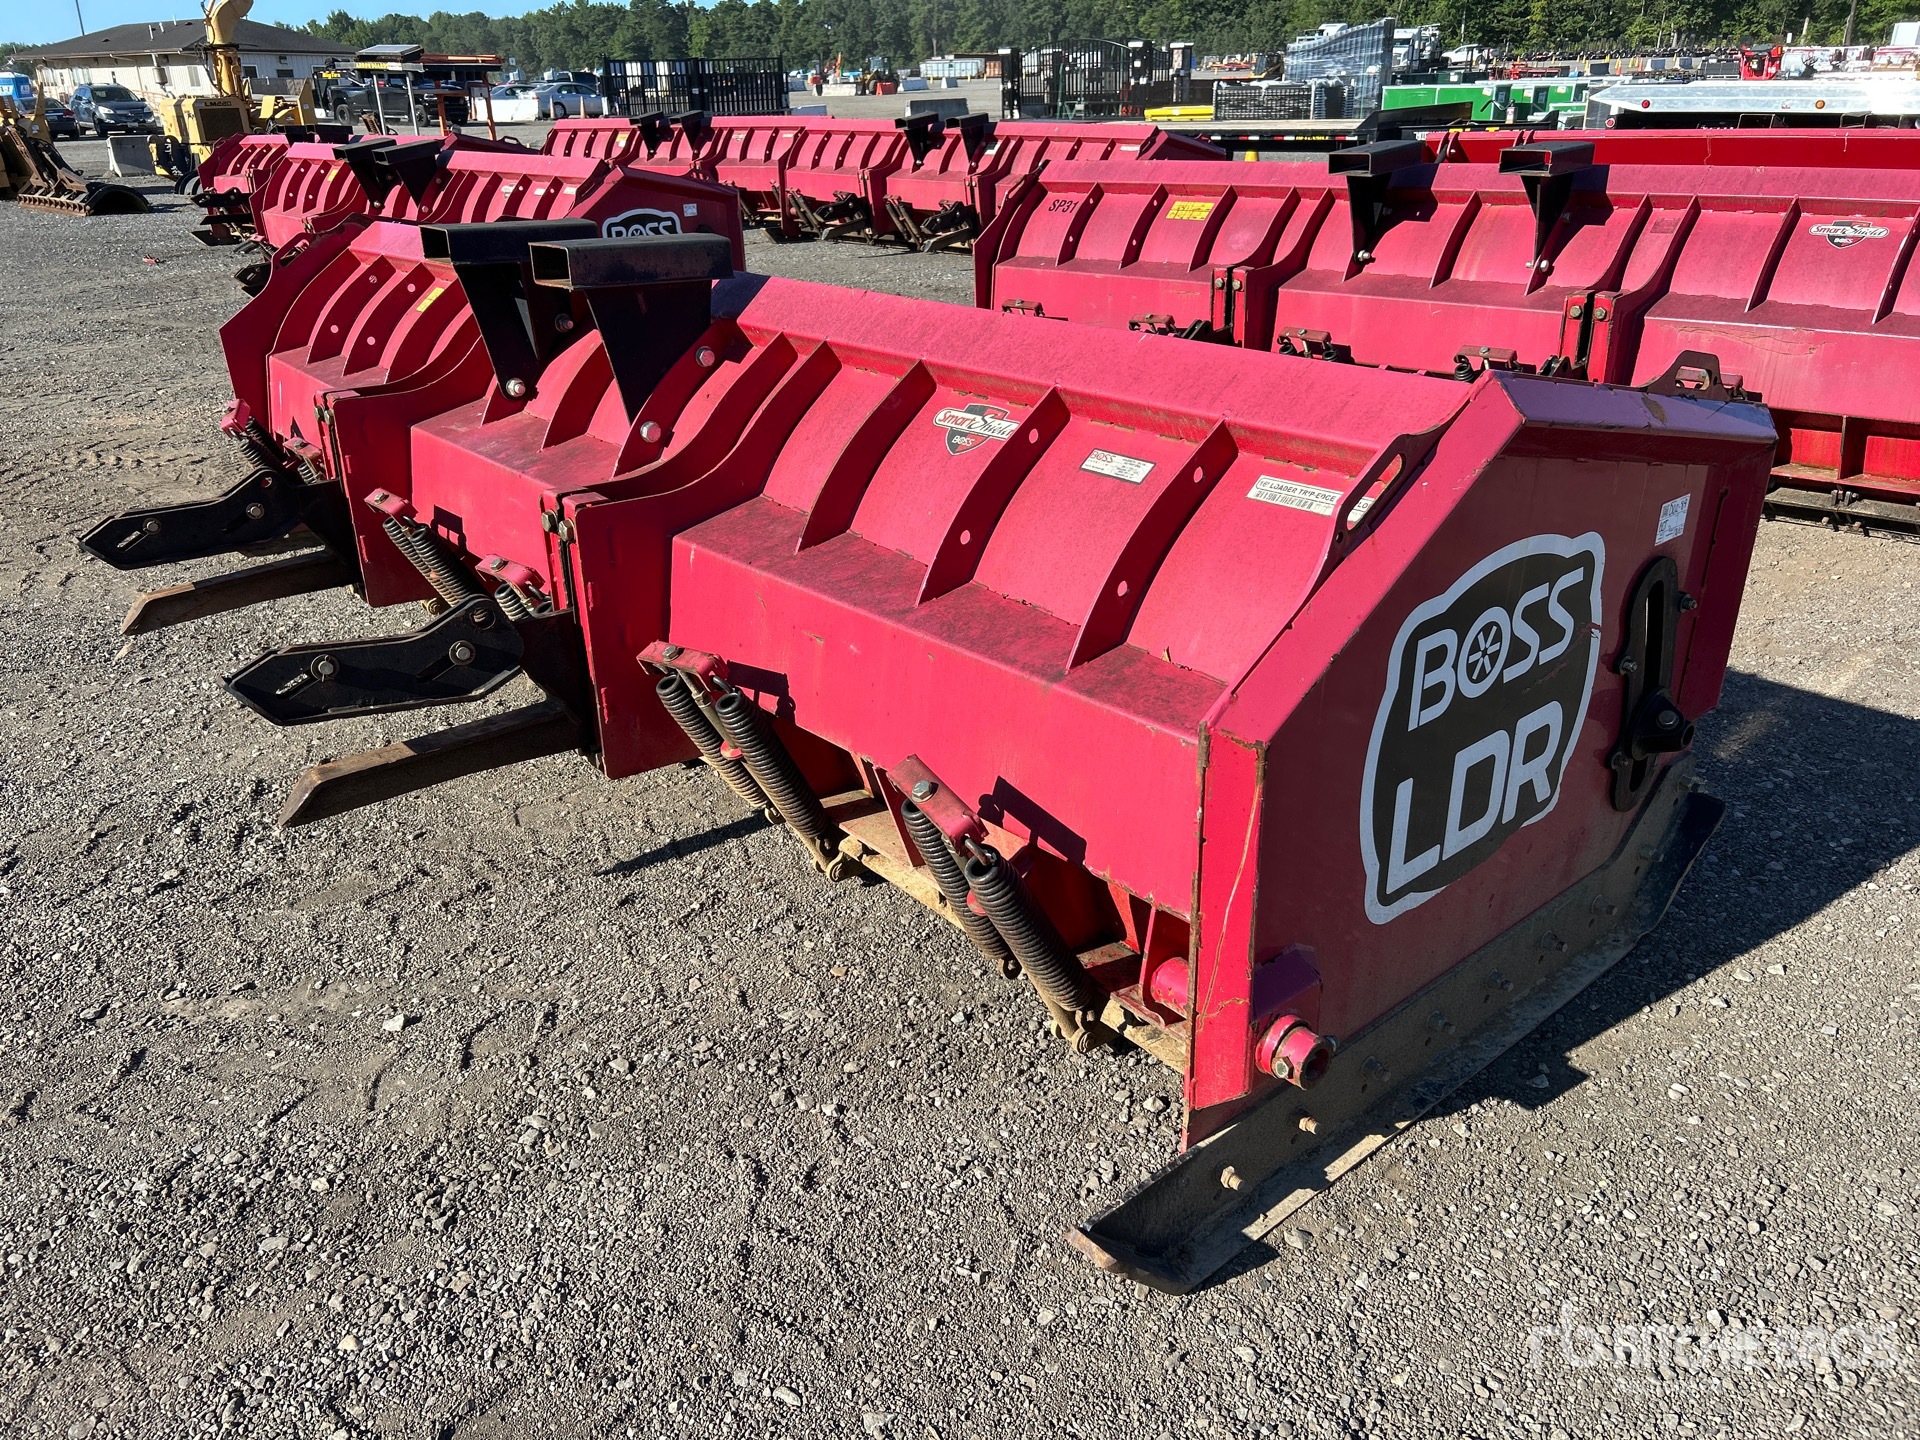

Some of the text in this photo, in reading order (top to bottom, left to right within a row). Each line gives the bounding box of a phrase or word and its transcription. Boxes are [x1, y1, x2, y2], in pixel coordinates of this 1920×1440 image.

[1048, 199, 1080, 214] SP31
[951, 435, 975, 447] BOSS
[1090, 451, 1117, 464] BOSS
[1269, 482, 1298, 494] LOADER
[1407, 566, 1584, 732] BOSS
[1386, 700, 1563, 895] LDR
